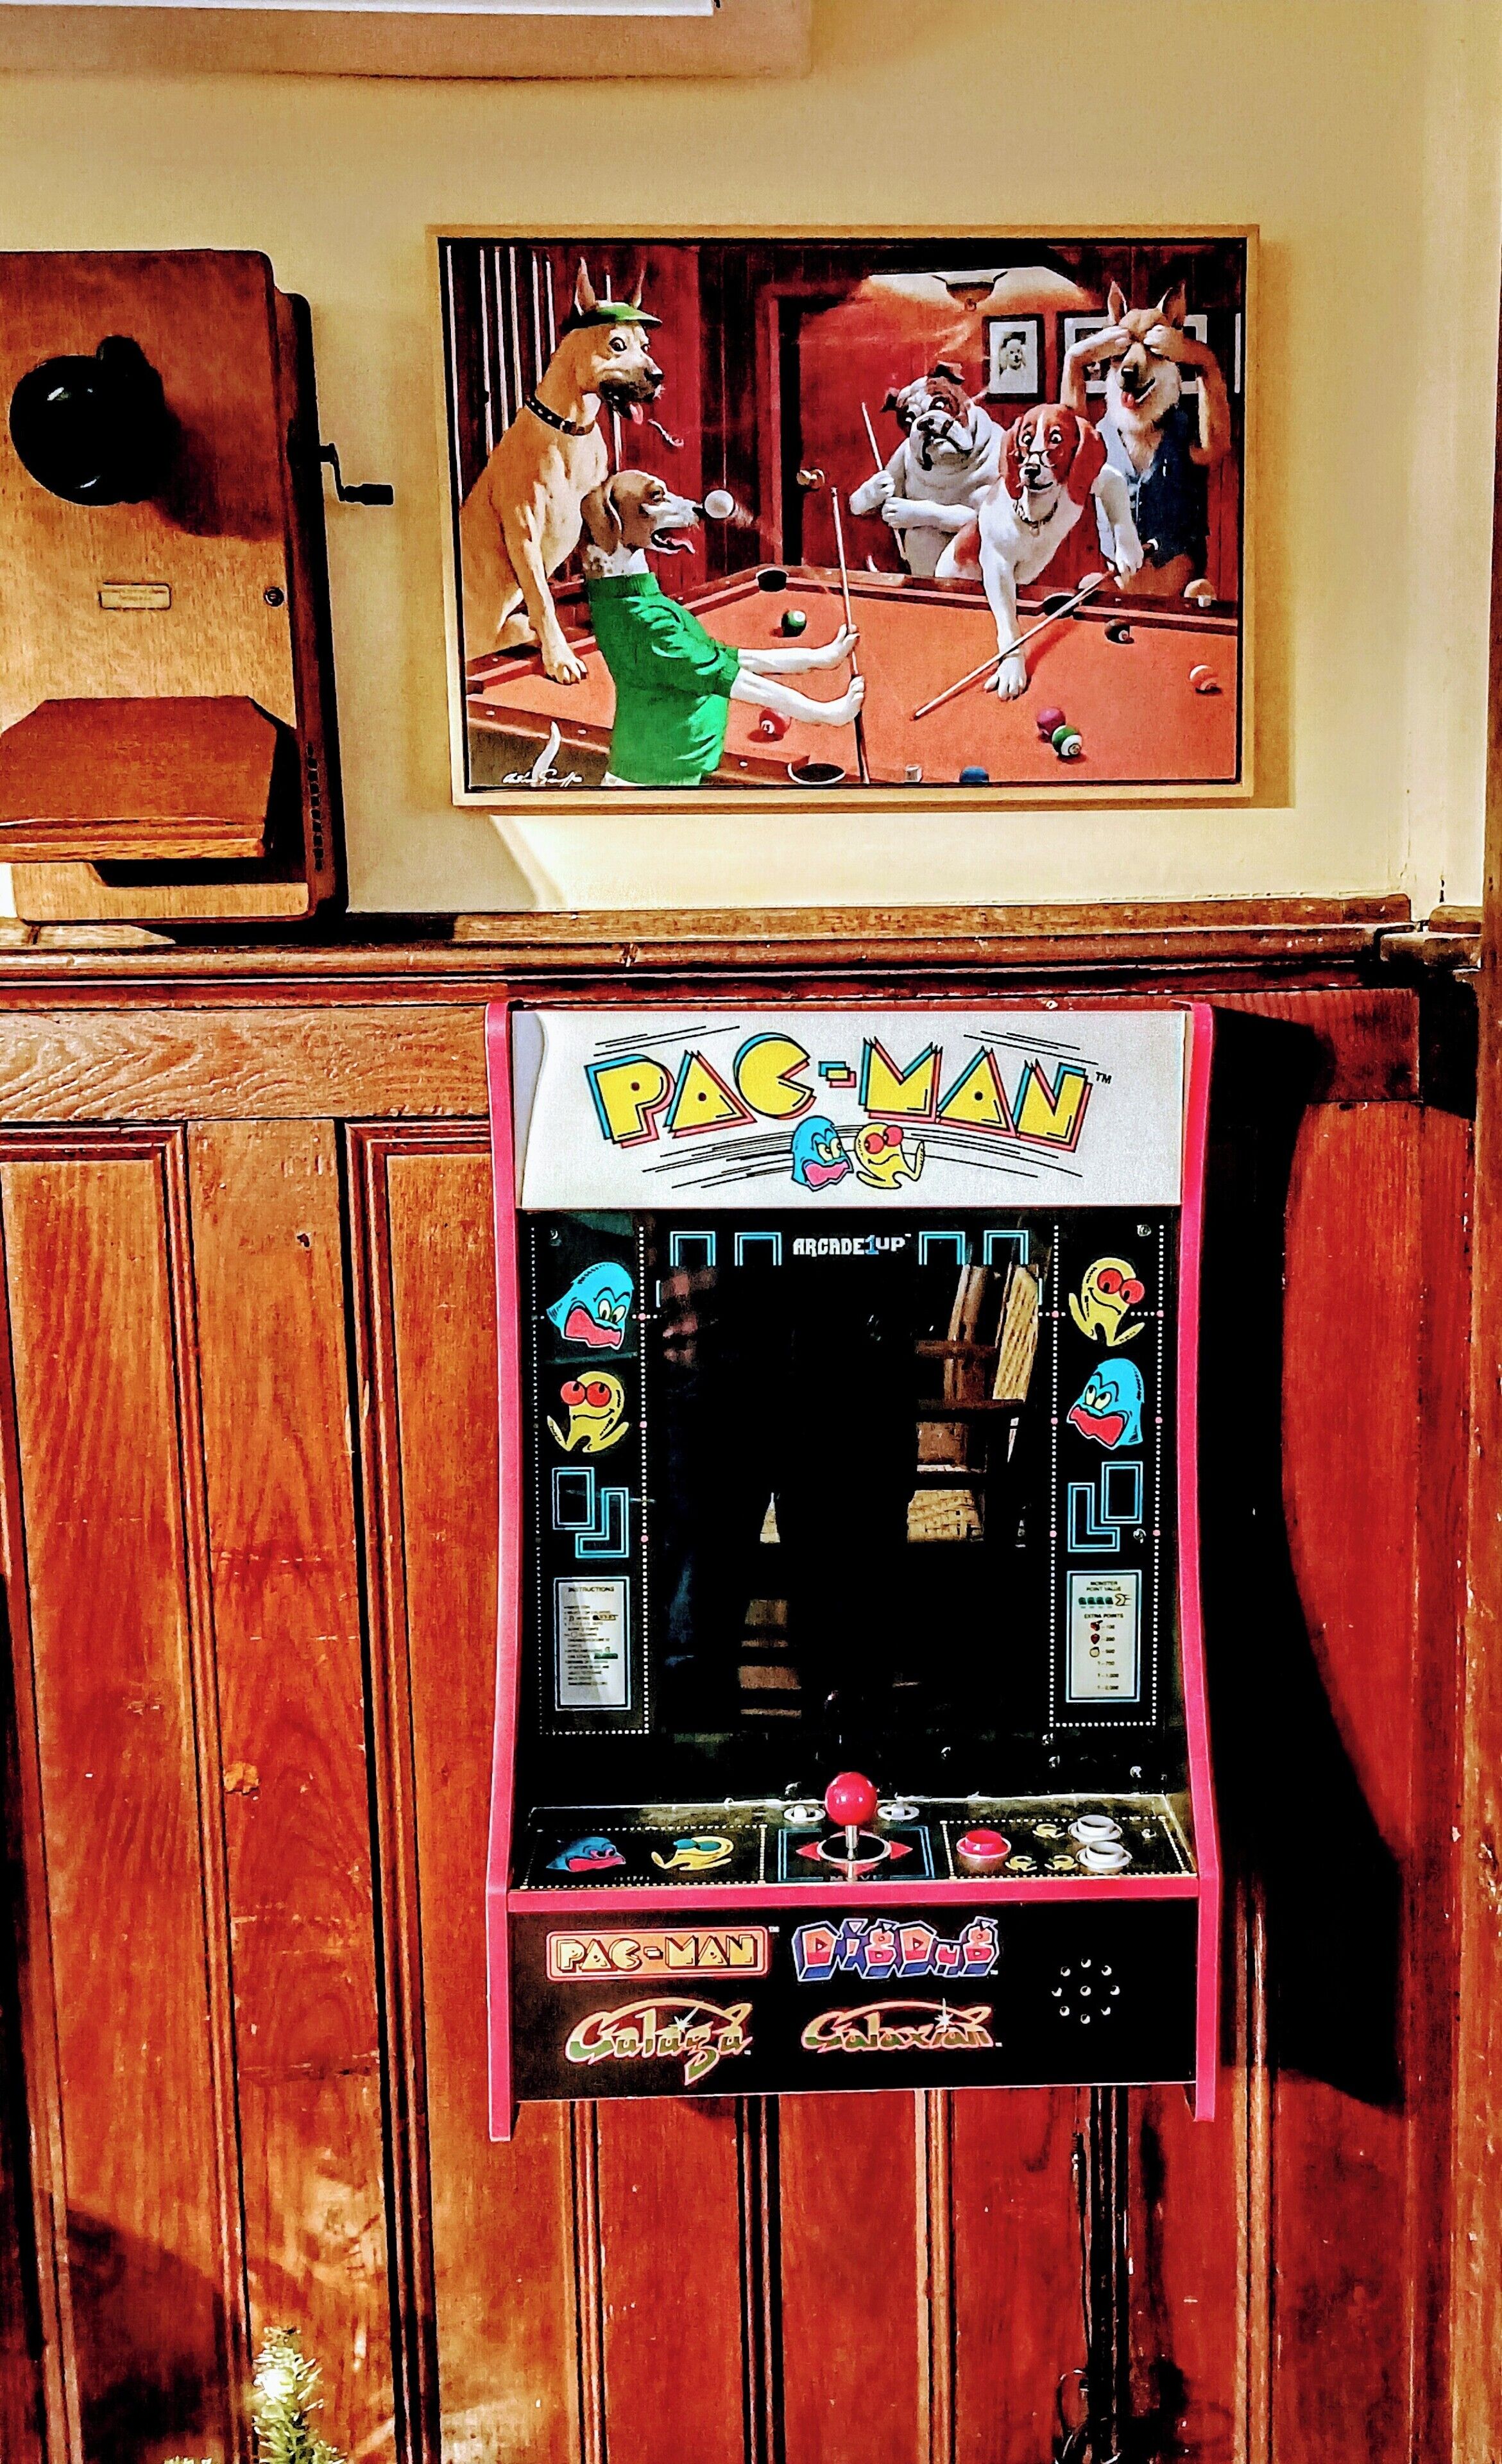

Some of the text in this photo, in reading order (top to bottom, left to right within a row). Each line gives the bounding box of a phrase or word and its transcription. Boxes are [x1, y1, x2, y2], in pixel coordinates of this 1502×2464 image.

[584, 1032, 1093, 1152] PAC-MAN
[792, 1235, 905, 1258] ARCADE1UP
[556, 1934, 758, 1973] PAC-MAN
[565, 1996, 753, 2086] Galaga
[801, 1998, 994, 2053] Galaxian
